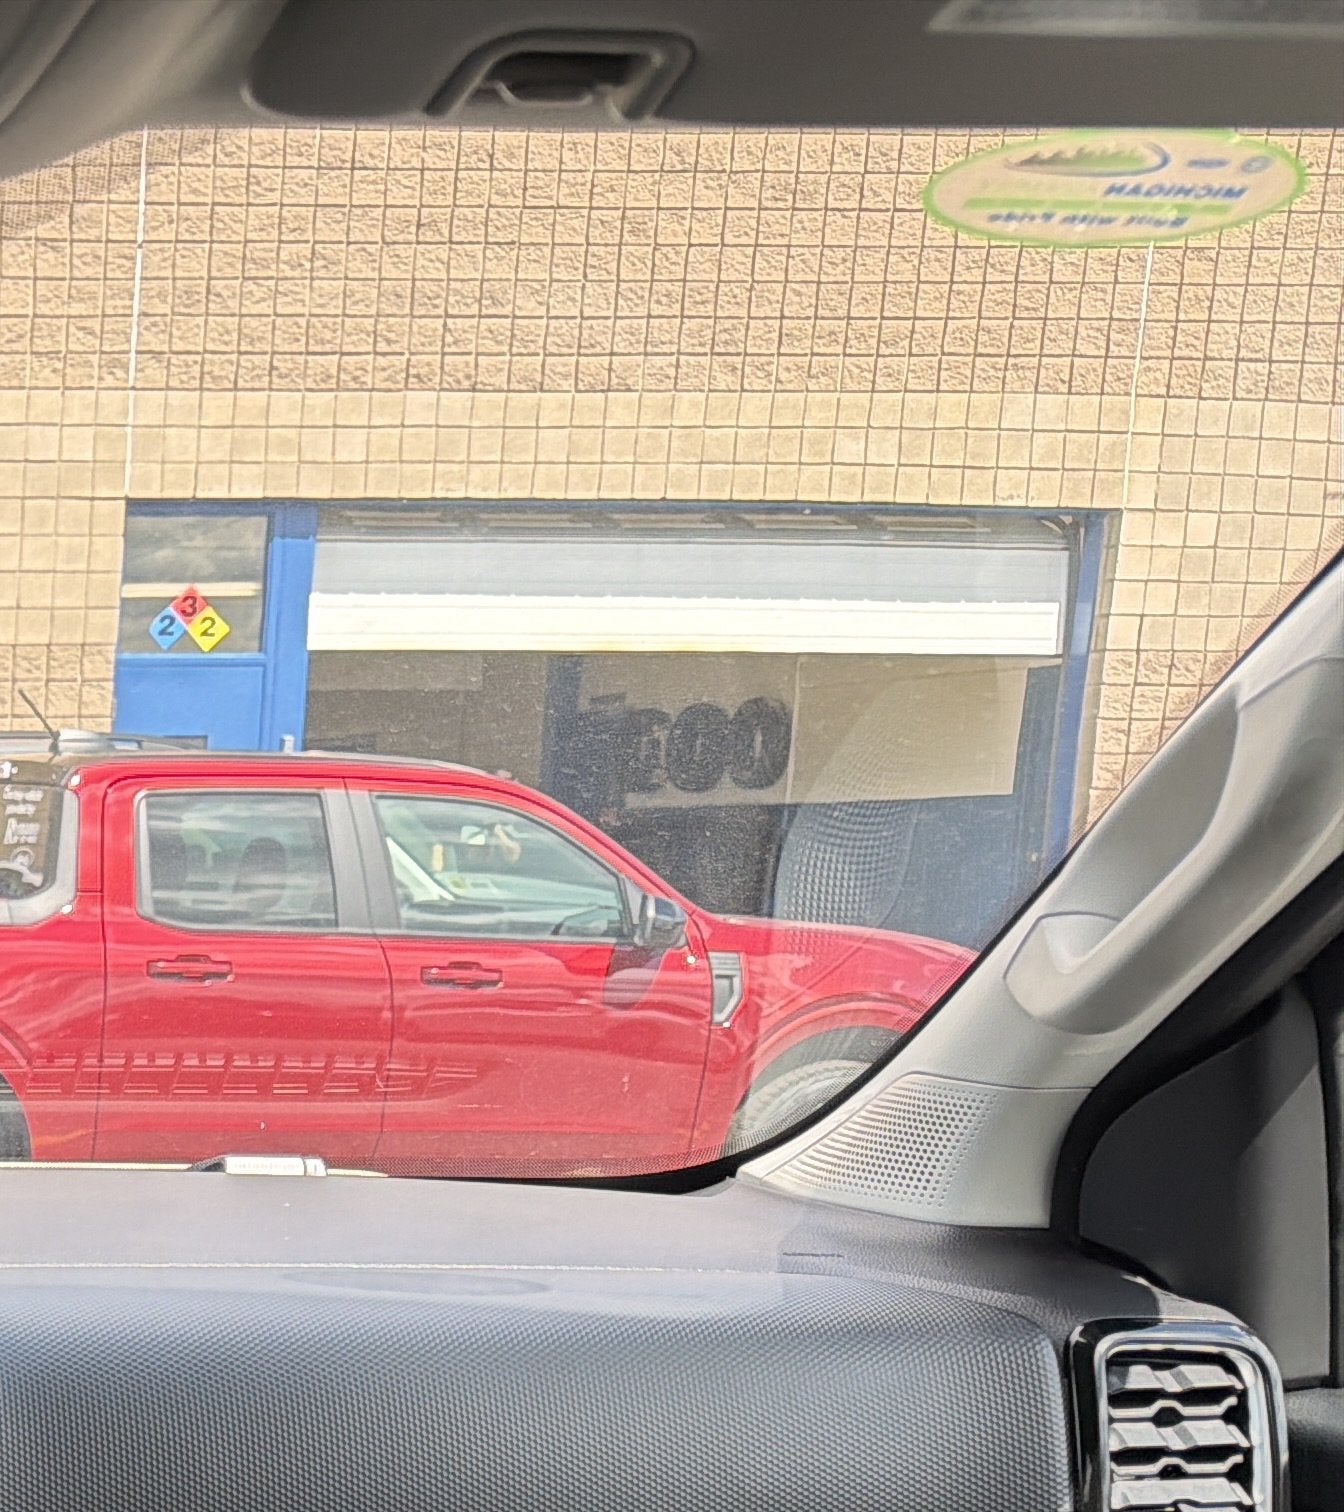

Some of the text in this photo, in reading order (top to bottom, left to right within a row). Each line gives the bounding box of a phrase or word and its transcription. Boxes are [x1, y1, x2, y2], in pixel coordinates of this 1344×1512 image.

[179, 595, 198, 617] 3
[158, 614, 176, 636] 2
[200, 616, 217, 637] 2
